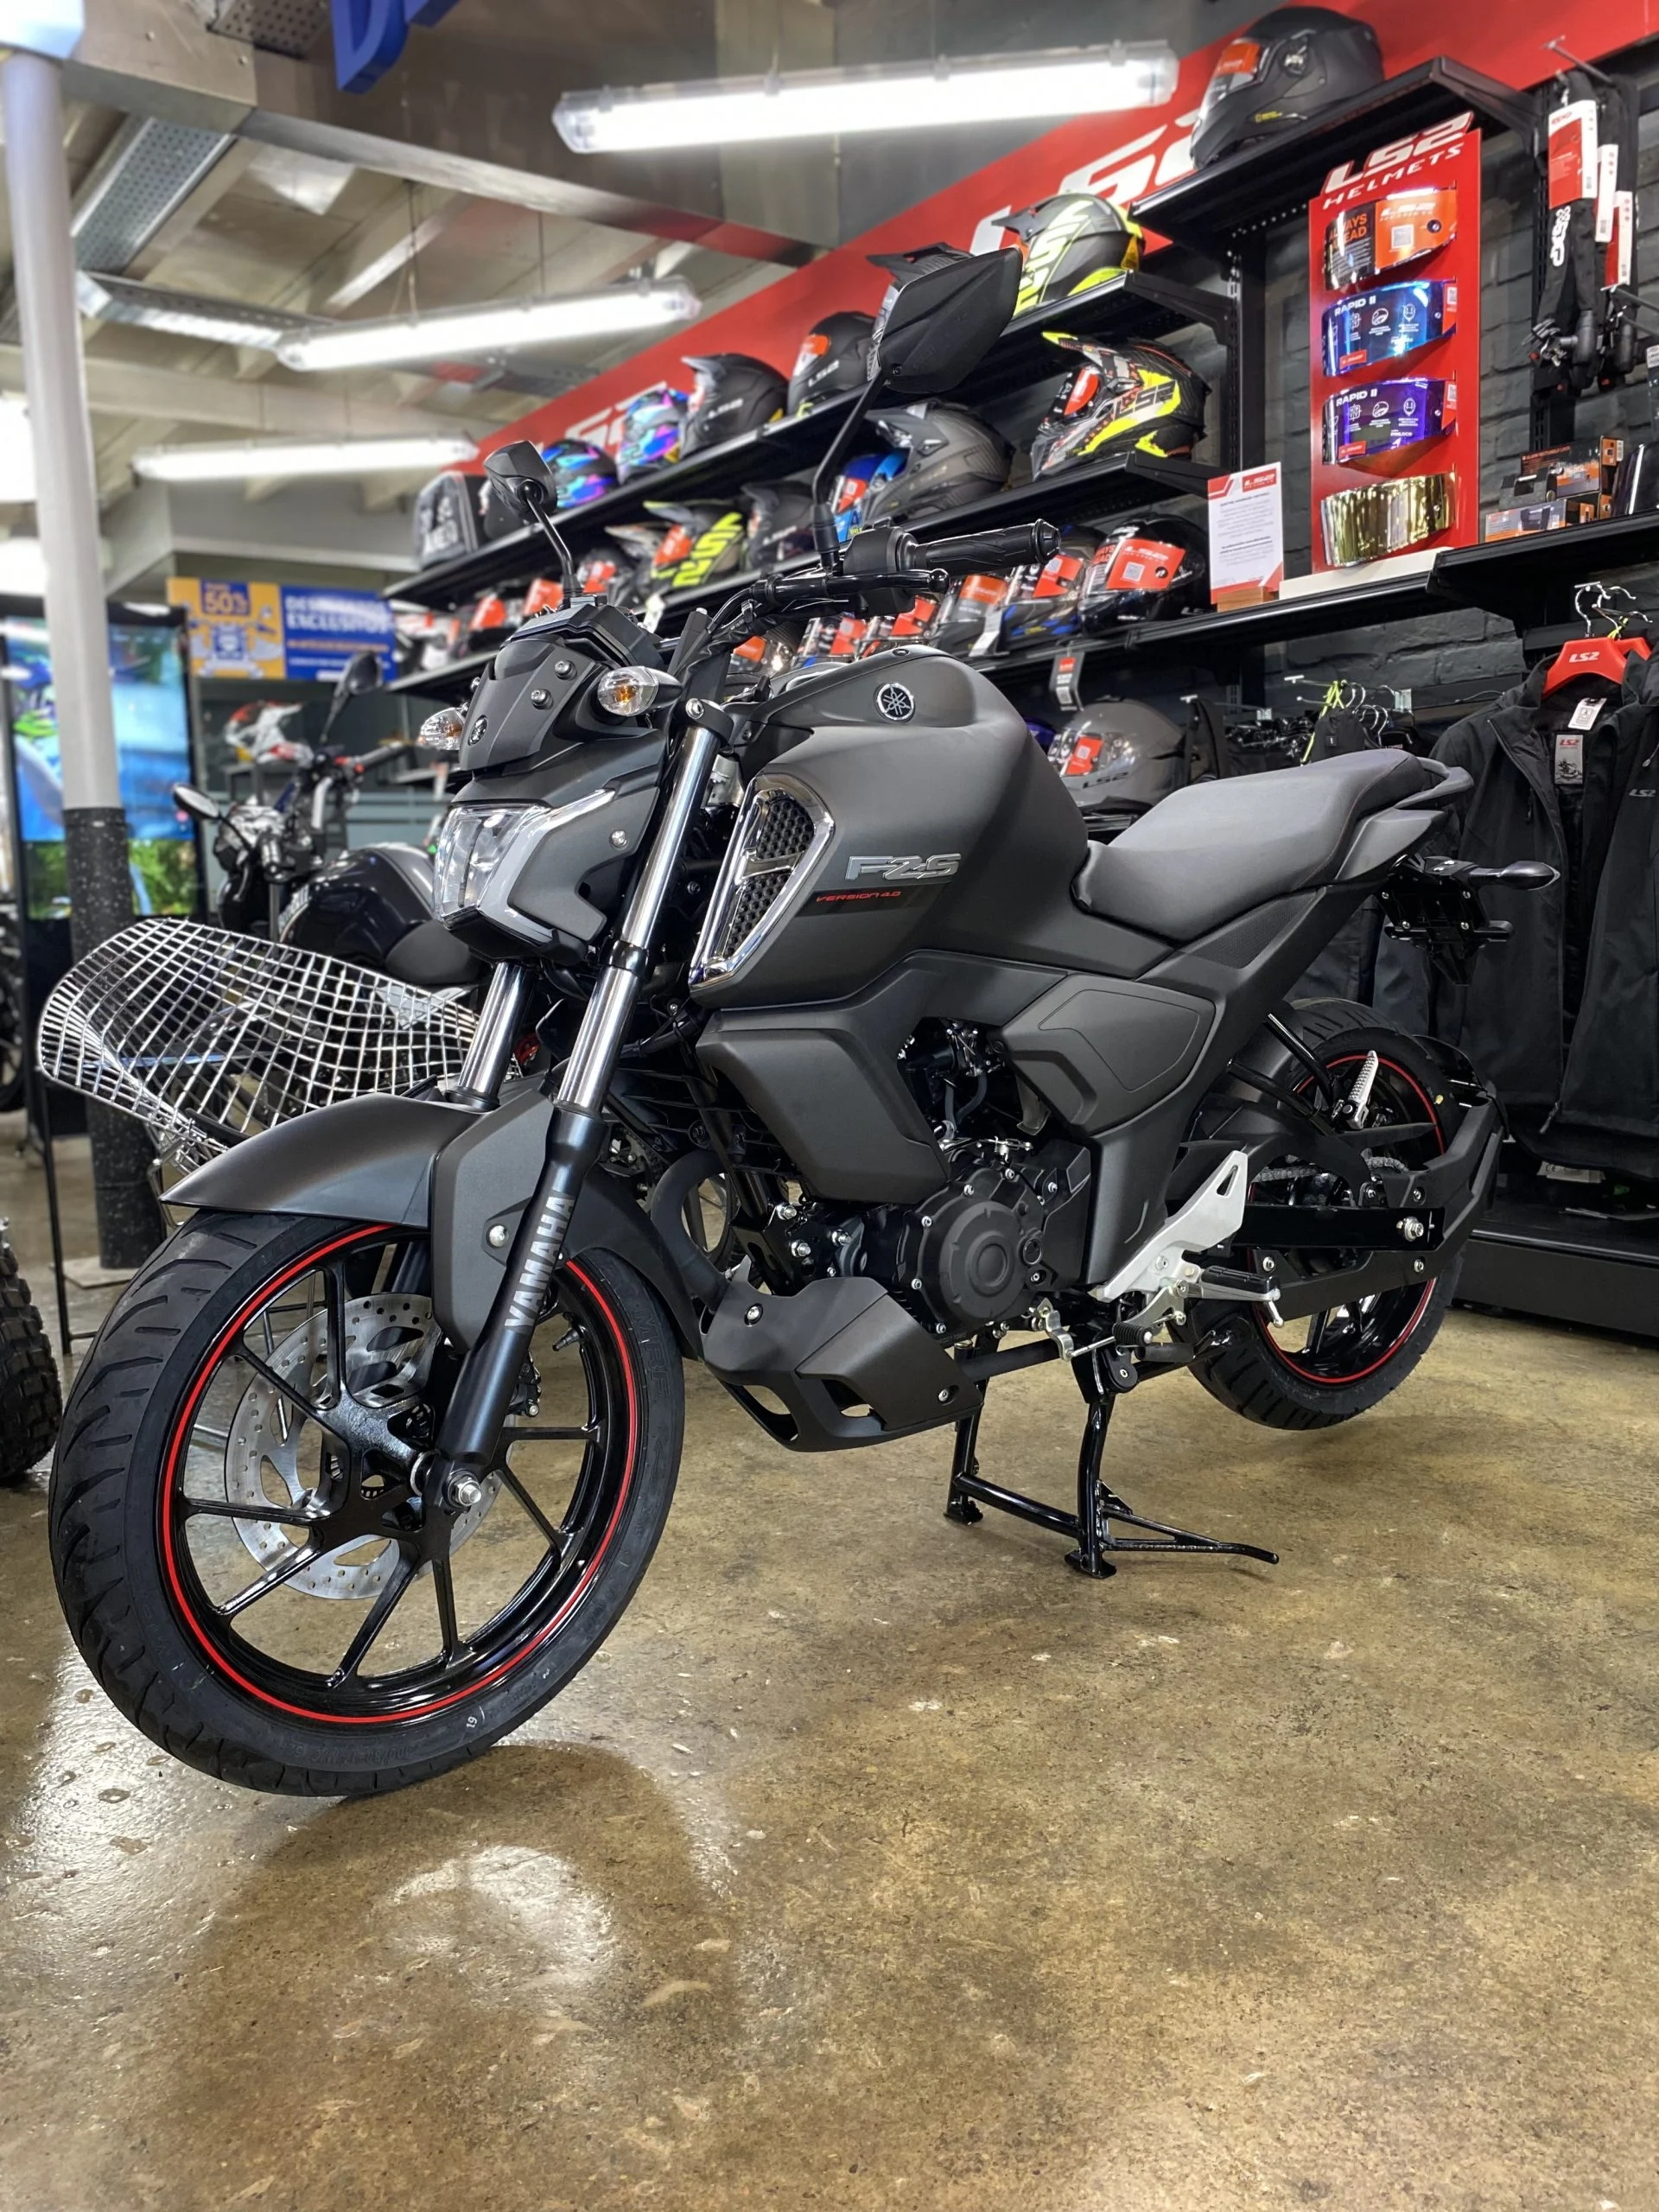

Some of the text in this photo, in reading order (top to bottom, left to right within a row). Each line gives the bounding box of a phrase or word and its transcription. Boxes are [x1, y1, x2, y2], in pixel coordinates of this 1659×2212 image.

[1324, 111, 1474, 194] LS2
[1323, 143, 1465, 210] HELMETS
[1334, 295, 1376, 316] RAPID II
[1336, 388, 1378, 407] RAPID II
[1568, 651, 1600, 663] LS2
[1083, 771, 1128, 789] LS2
[1629, 788, 1656, 798] LS2
[816, 892, 880, 903] VERSION
[504, 1196, 576, 1327] YAMAHA
